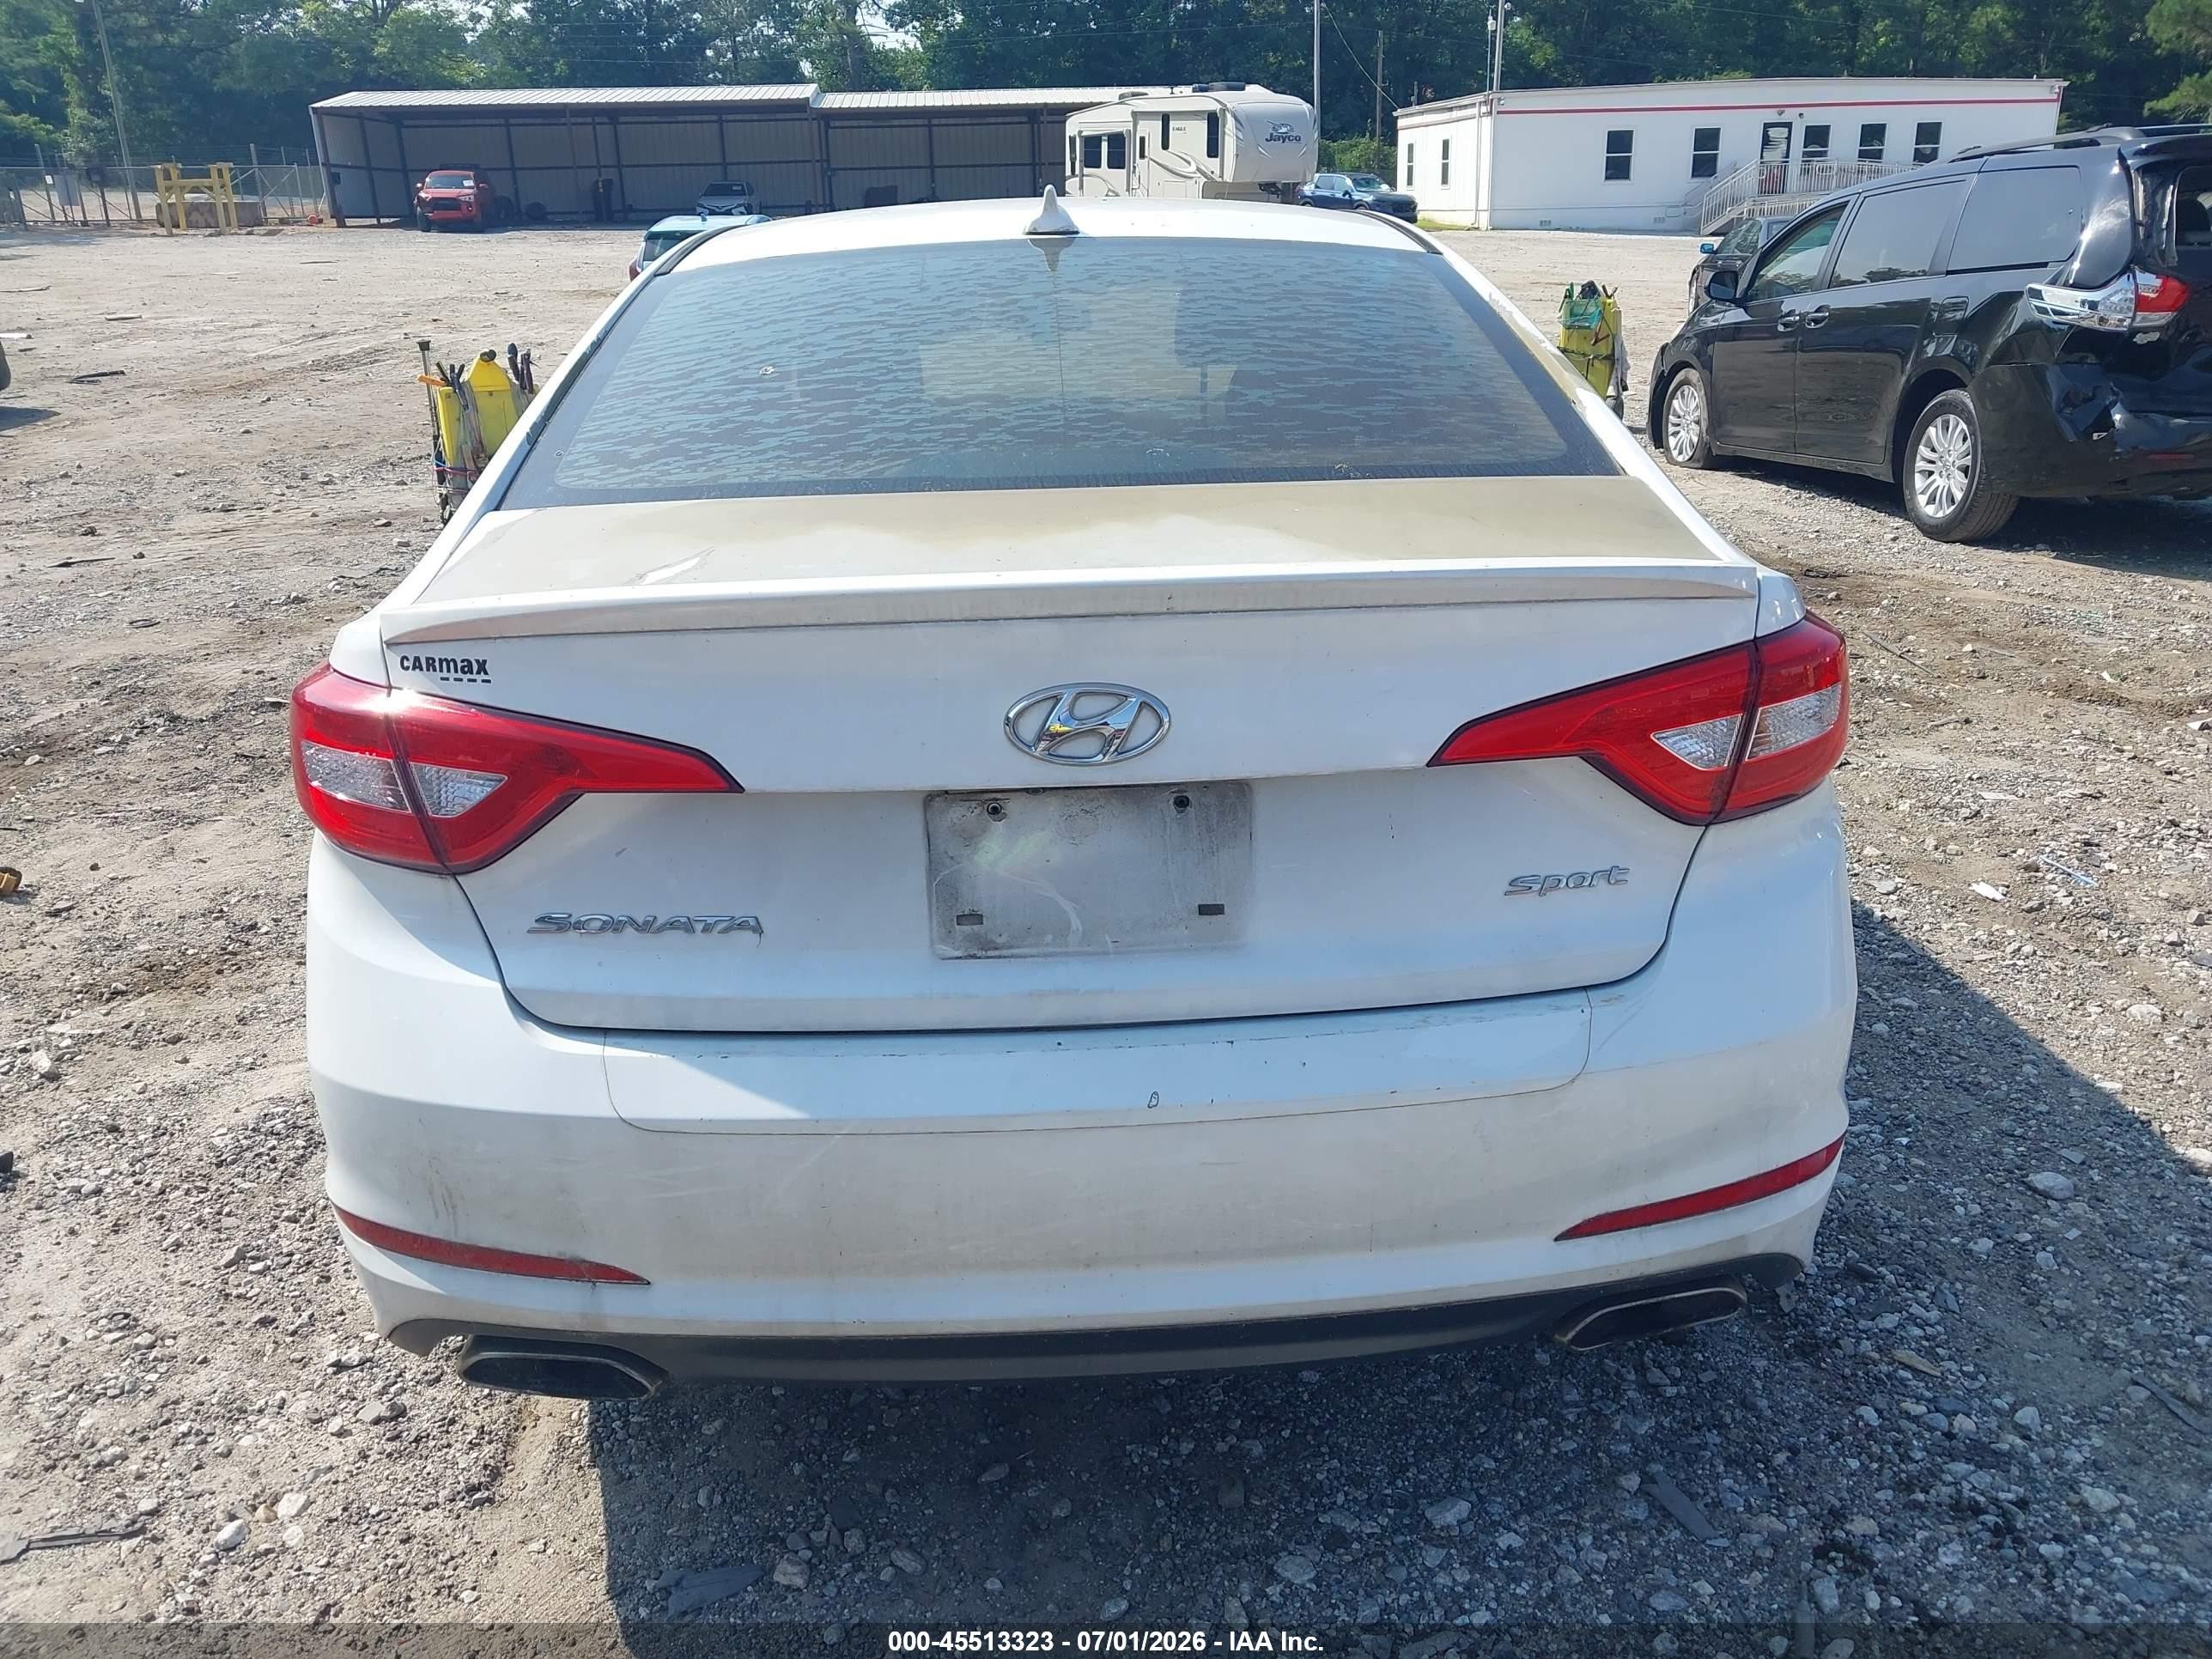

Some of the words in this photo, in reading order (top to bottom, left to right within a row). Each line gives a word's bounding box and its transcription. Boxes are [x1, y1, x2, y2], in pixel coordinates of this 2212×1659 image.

[1265, 132, 1302, 143] Jayco
[1504, 866, 1630, 896] Sport
[526, 913, 763, 934] SONATA
